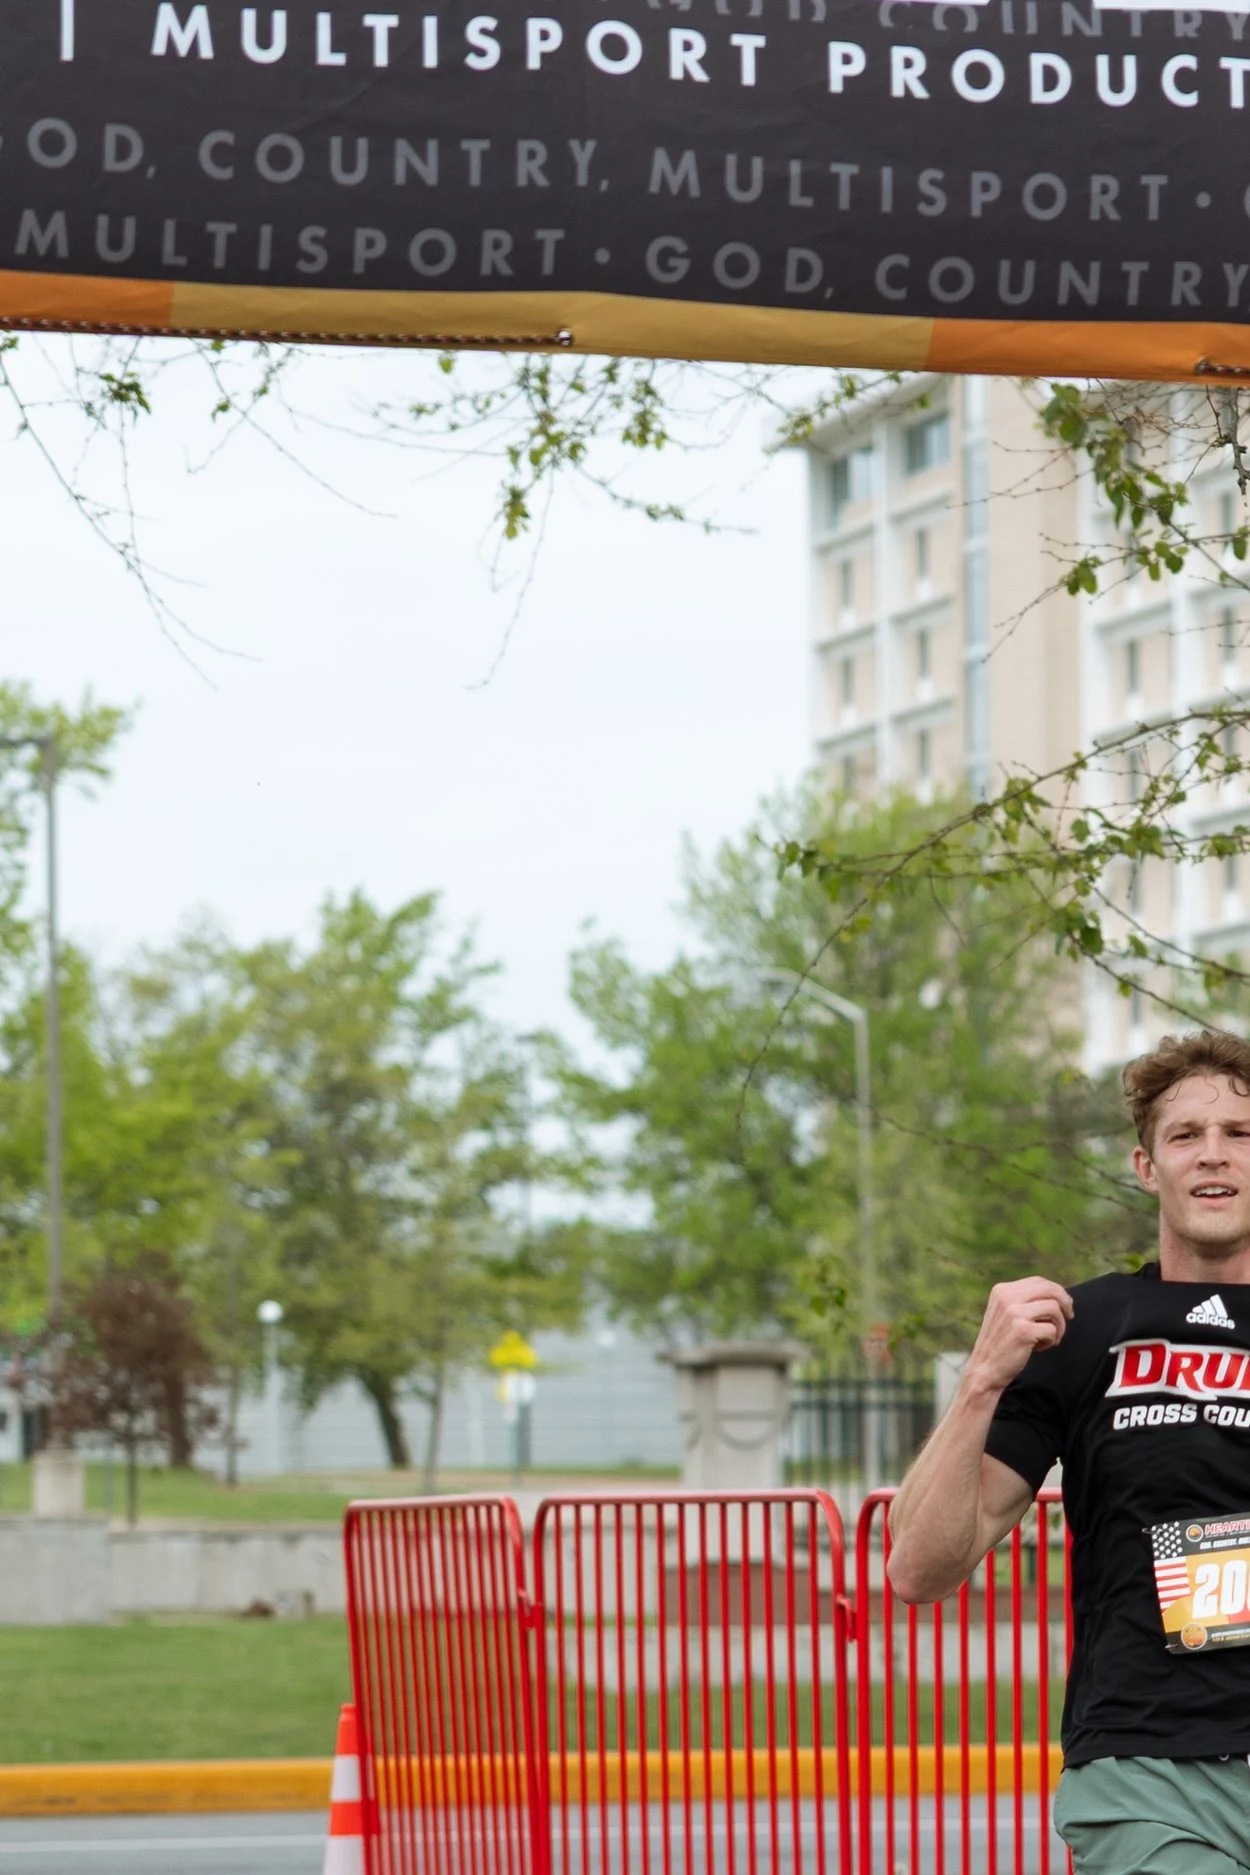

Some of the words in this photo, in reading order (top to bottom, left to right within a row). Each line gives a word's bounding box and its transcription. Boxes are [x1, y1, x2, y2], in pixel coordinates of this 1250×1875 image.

[150, 2, 767, 87] MULTISPORT
[0, 117, 157, 179] OD,
[198, 130, 609, 192] COUNTRY,
[648, 147, 1168, 221] MULTISPORT
[15, 208, 565, 275] MULTISPORT
[646, 236, 833, 298] GOD,
[1186, 1311, 1236, 1329] adidas
[1112, 1403, 1198, 1430] CROSS
